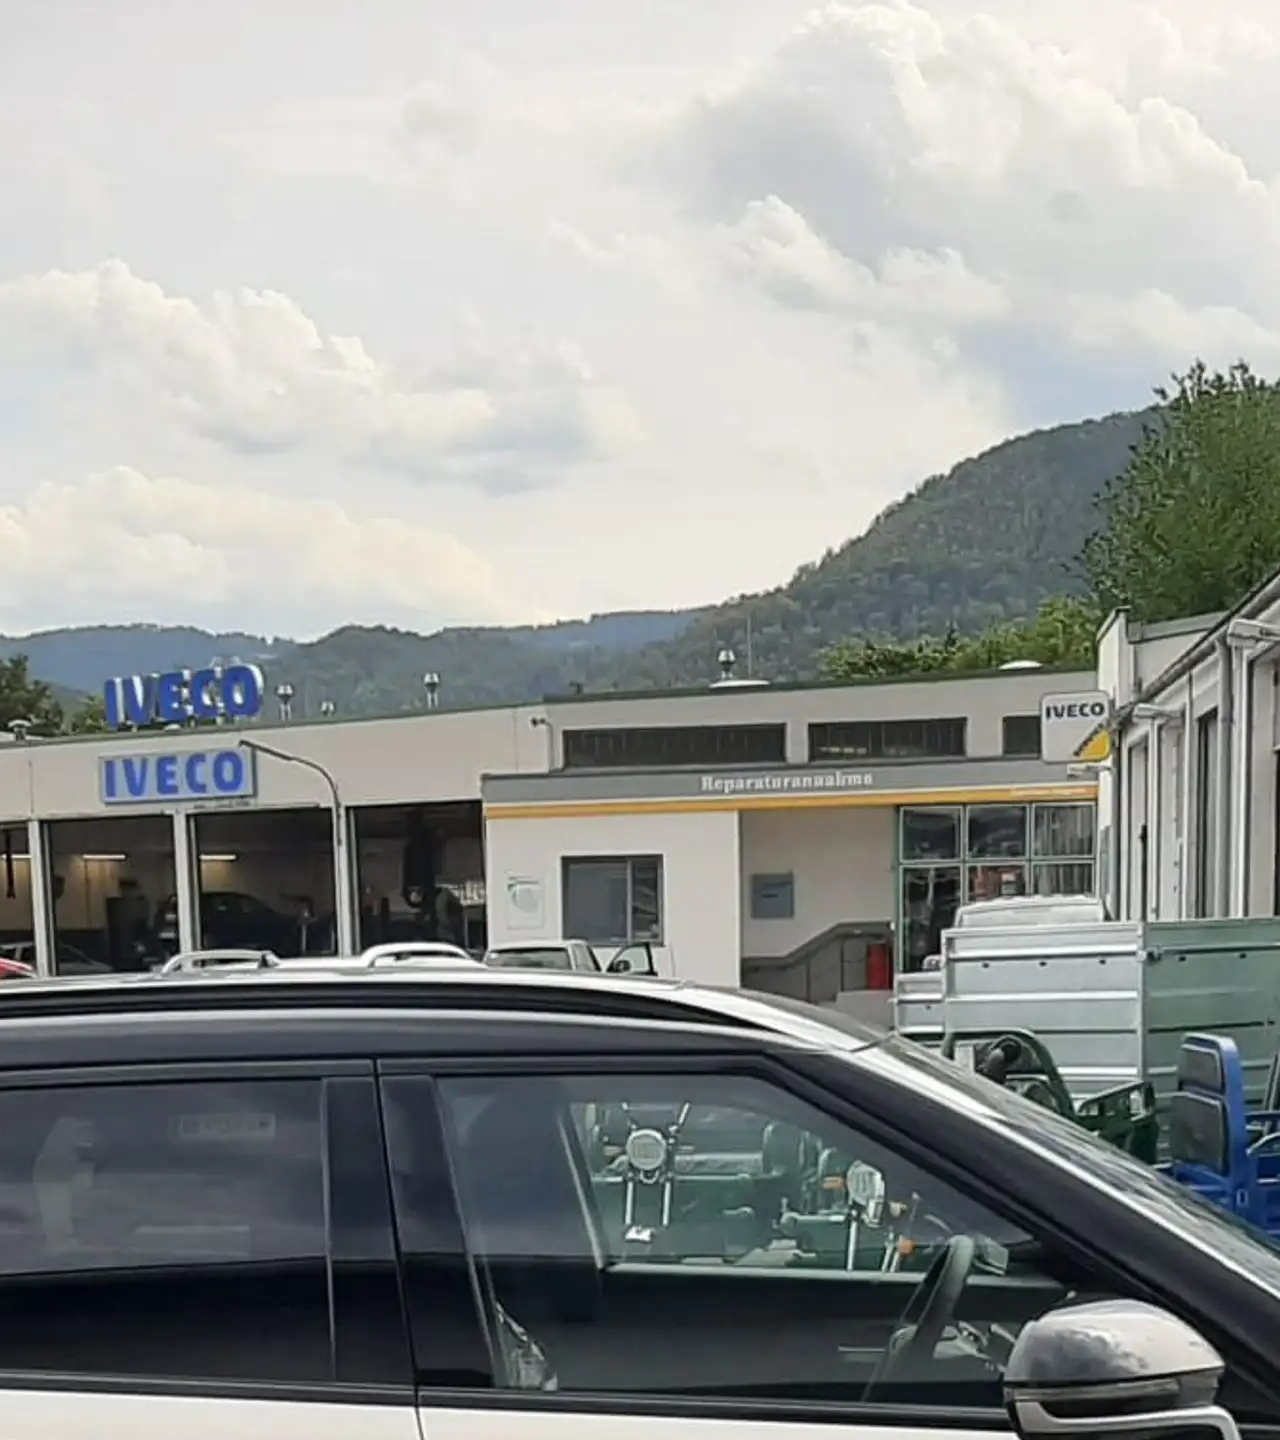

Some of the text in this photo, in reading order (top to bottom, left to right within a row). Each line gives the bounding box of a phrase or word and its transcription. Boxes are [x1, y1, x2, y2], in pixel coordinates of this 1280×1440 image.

[104, 665, 261, 728] IVECO
[1045, 702, 1105, 720] IVECO
[104, 751, 243, 798] IVECO
